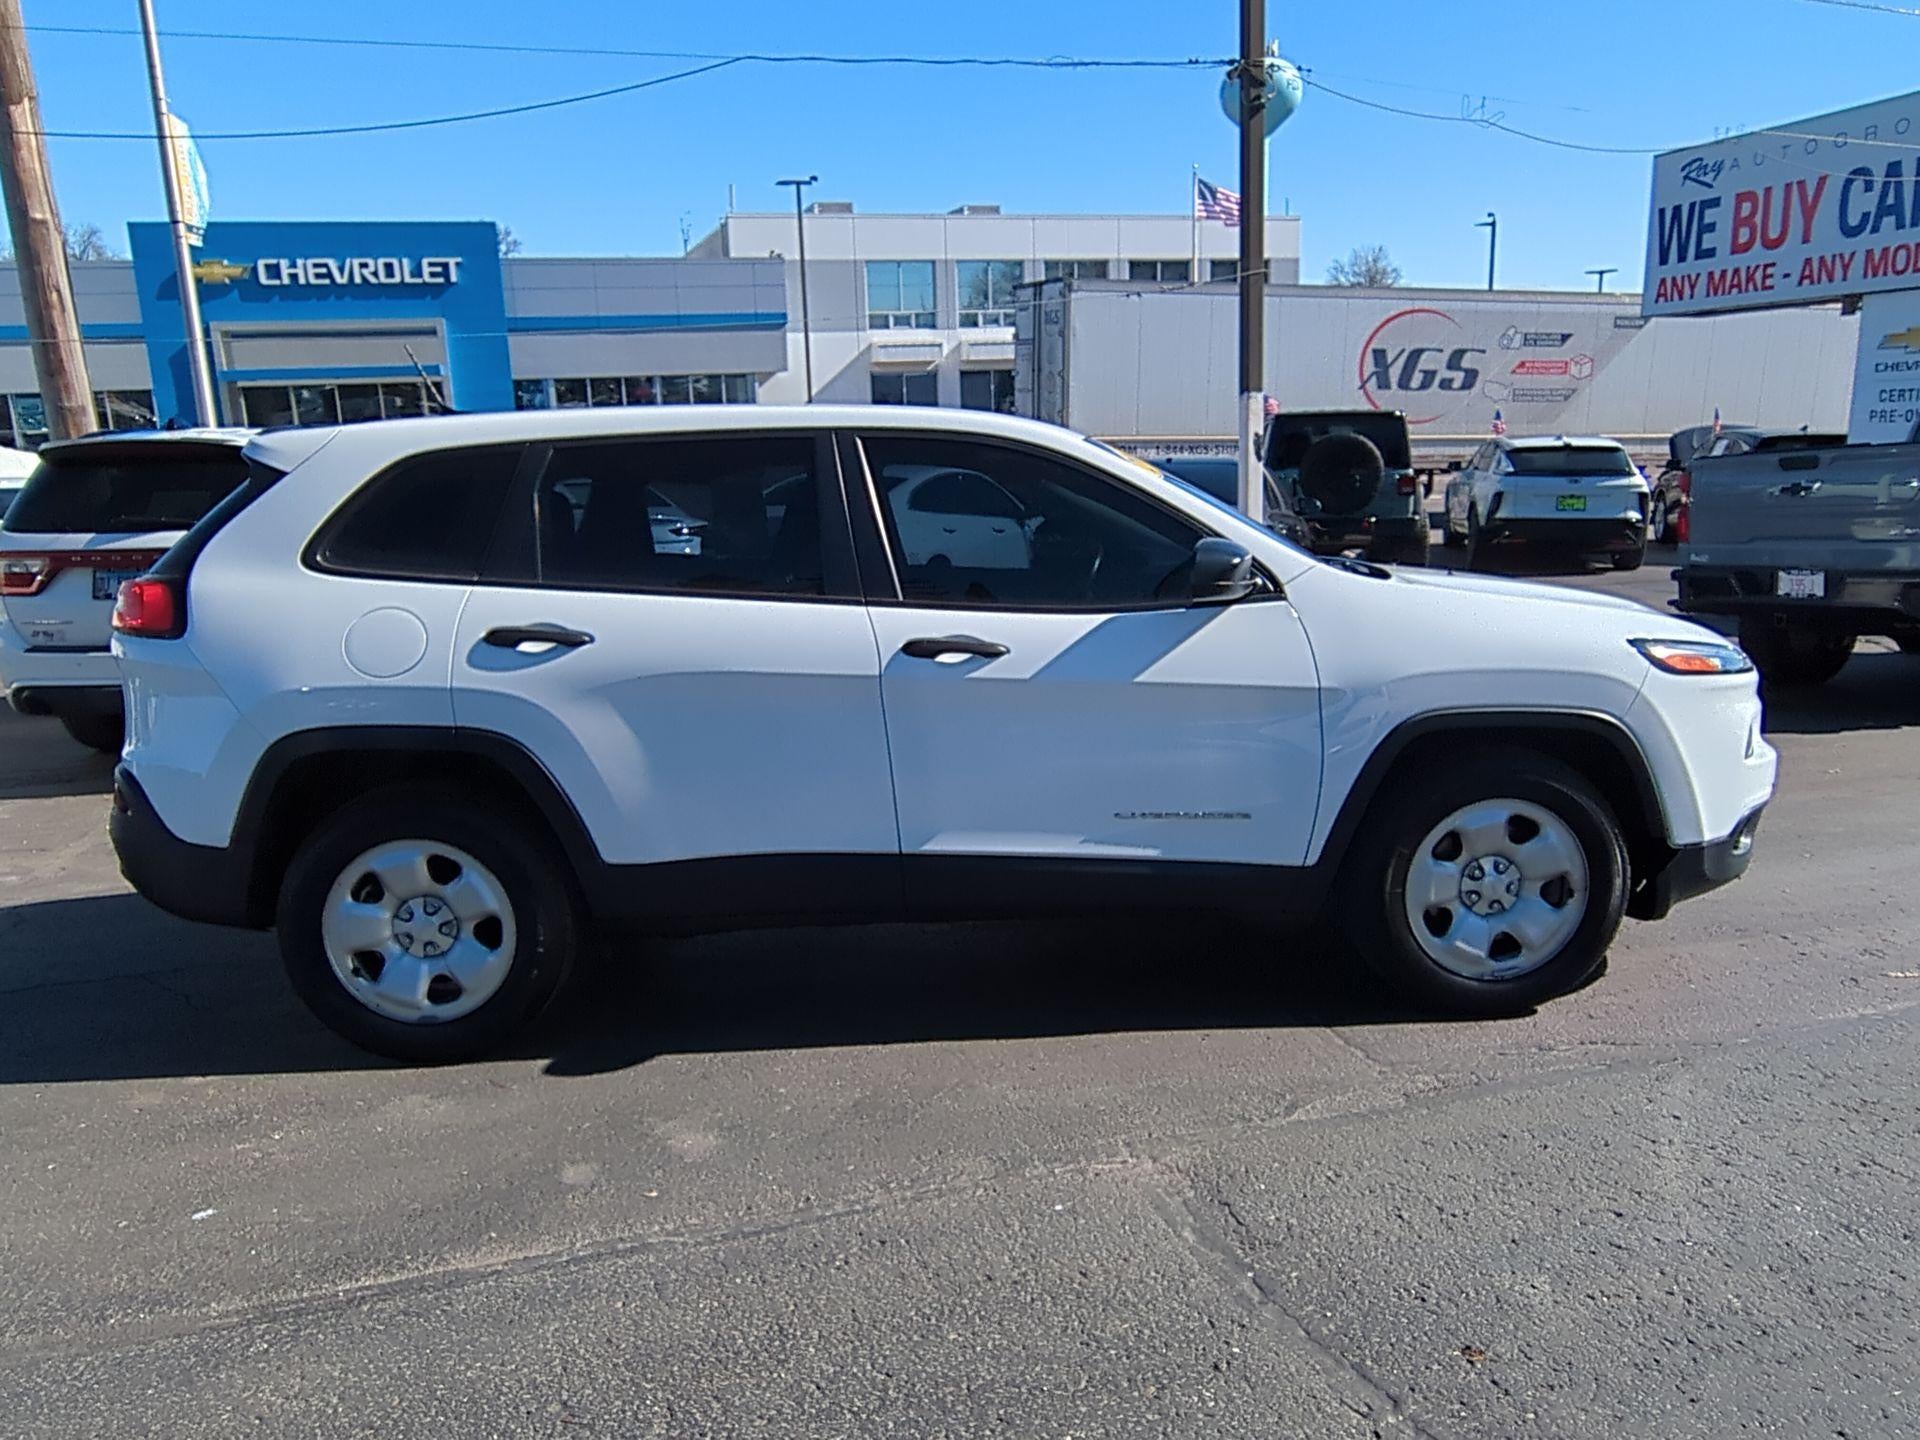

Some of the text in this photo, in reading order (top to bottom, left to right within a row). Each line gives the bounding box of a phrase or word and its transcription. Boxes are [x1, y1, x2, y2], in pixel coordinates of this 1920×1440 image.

[1680, 157, 1725, 189] Ray
[1657, 196, 1722, 267] WE
[1730, 174, 1829, 256] BUY
[257, 256, 464, 286] CHEVROLET
[1655, 273, 1701, 304] ANY
[1706, 262, 1777, 298] MAKE
[1798, 251, 1857, 287] ANY
[1358, 347, 1487, 391] XGS
[1869, 408, 1920, 423] PRE-O
